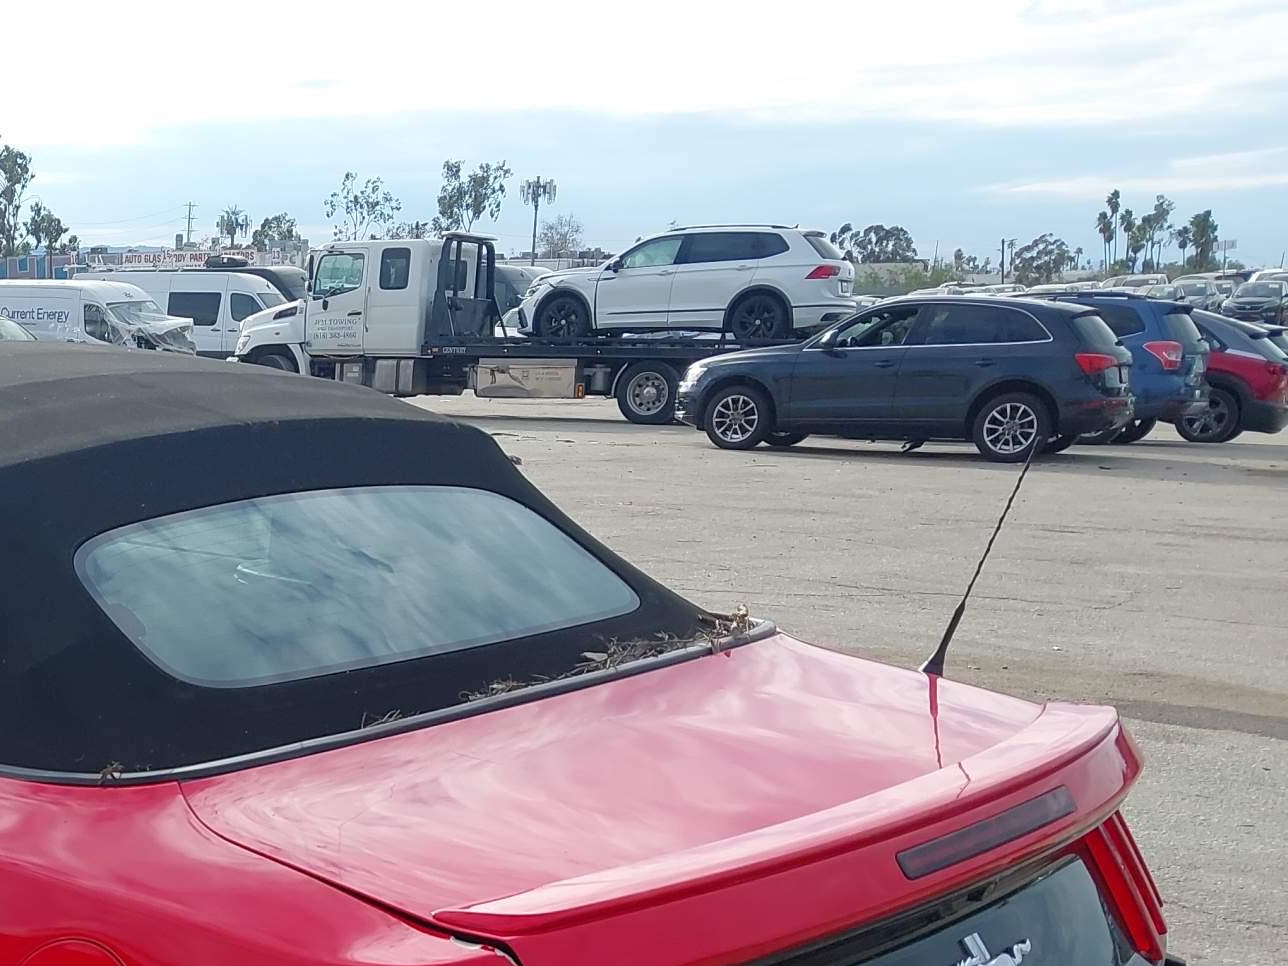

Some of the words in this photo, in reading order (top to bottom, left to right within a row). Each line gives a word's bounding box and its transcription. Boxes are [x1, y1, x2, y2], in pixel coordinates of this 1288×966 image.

[124, 253, 142, 264] AUTO
[144, 253, 165, 264] GLAS
[168, 253, 187, 263] ODY
[0, 306, 35, 320] Current
[37, 307, 70, 323] Energy
